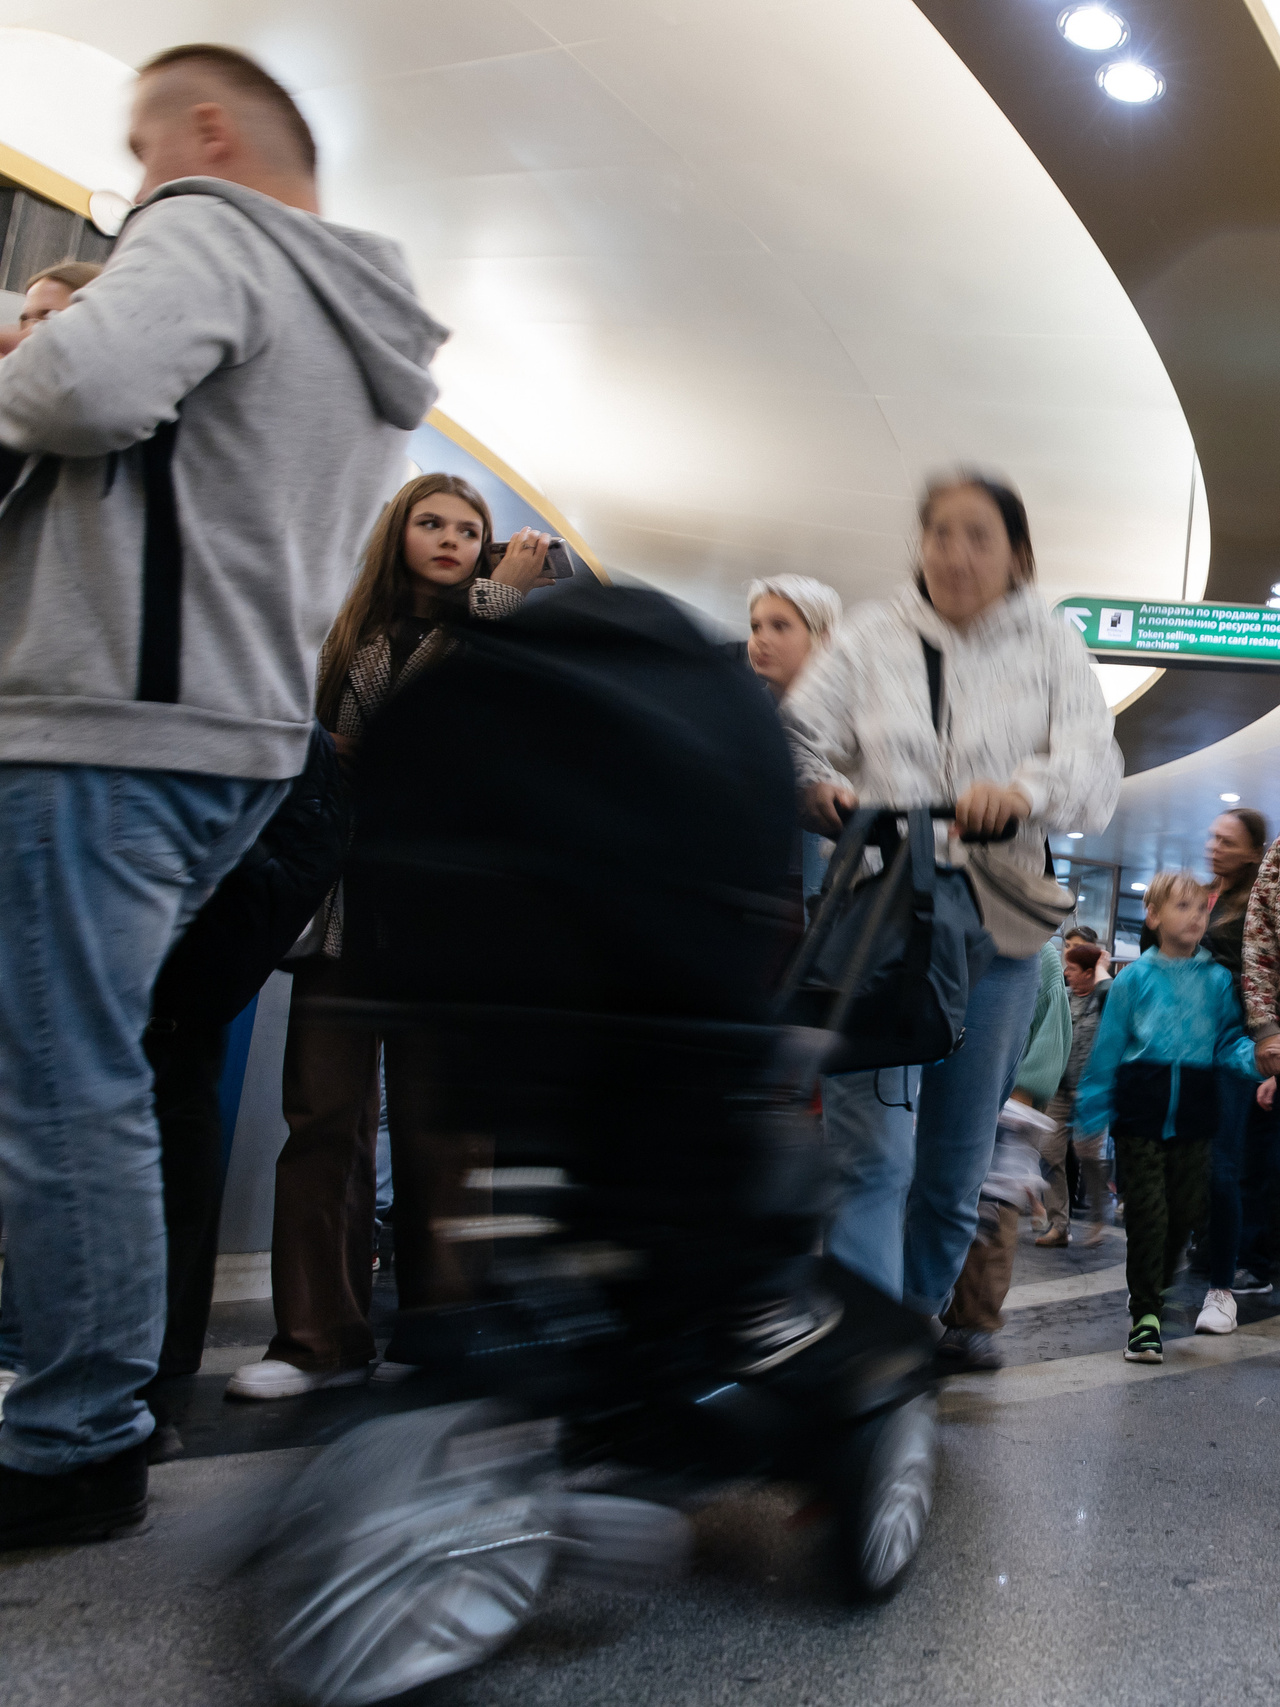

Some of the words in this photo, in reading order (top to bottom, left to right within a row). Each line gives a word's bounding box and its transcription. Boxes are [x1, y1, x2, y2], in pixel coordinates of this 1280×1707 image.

[1140, 604, 1194, 616] Аппараты
[1196, 609, 1210, 618] по
[1212, 610, 1260, 621] продаже
[1139, 617, 1146, 625] и
[1149, 617, 1217, 630] пополнению
[1218, 621, 1261, 633] ресурса
[1136, 640, 1180, 650] machines
[1138, 629, 1164, 640] Token
[1165, 631, 1198, 643] selling,
[1200, 634, 1226, 644] smart
[1227, 635, 1248, 646] card
